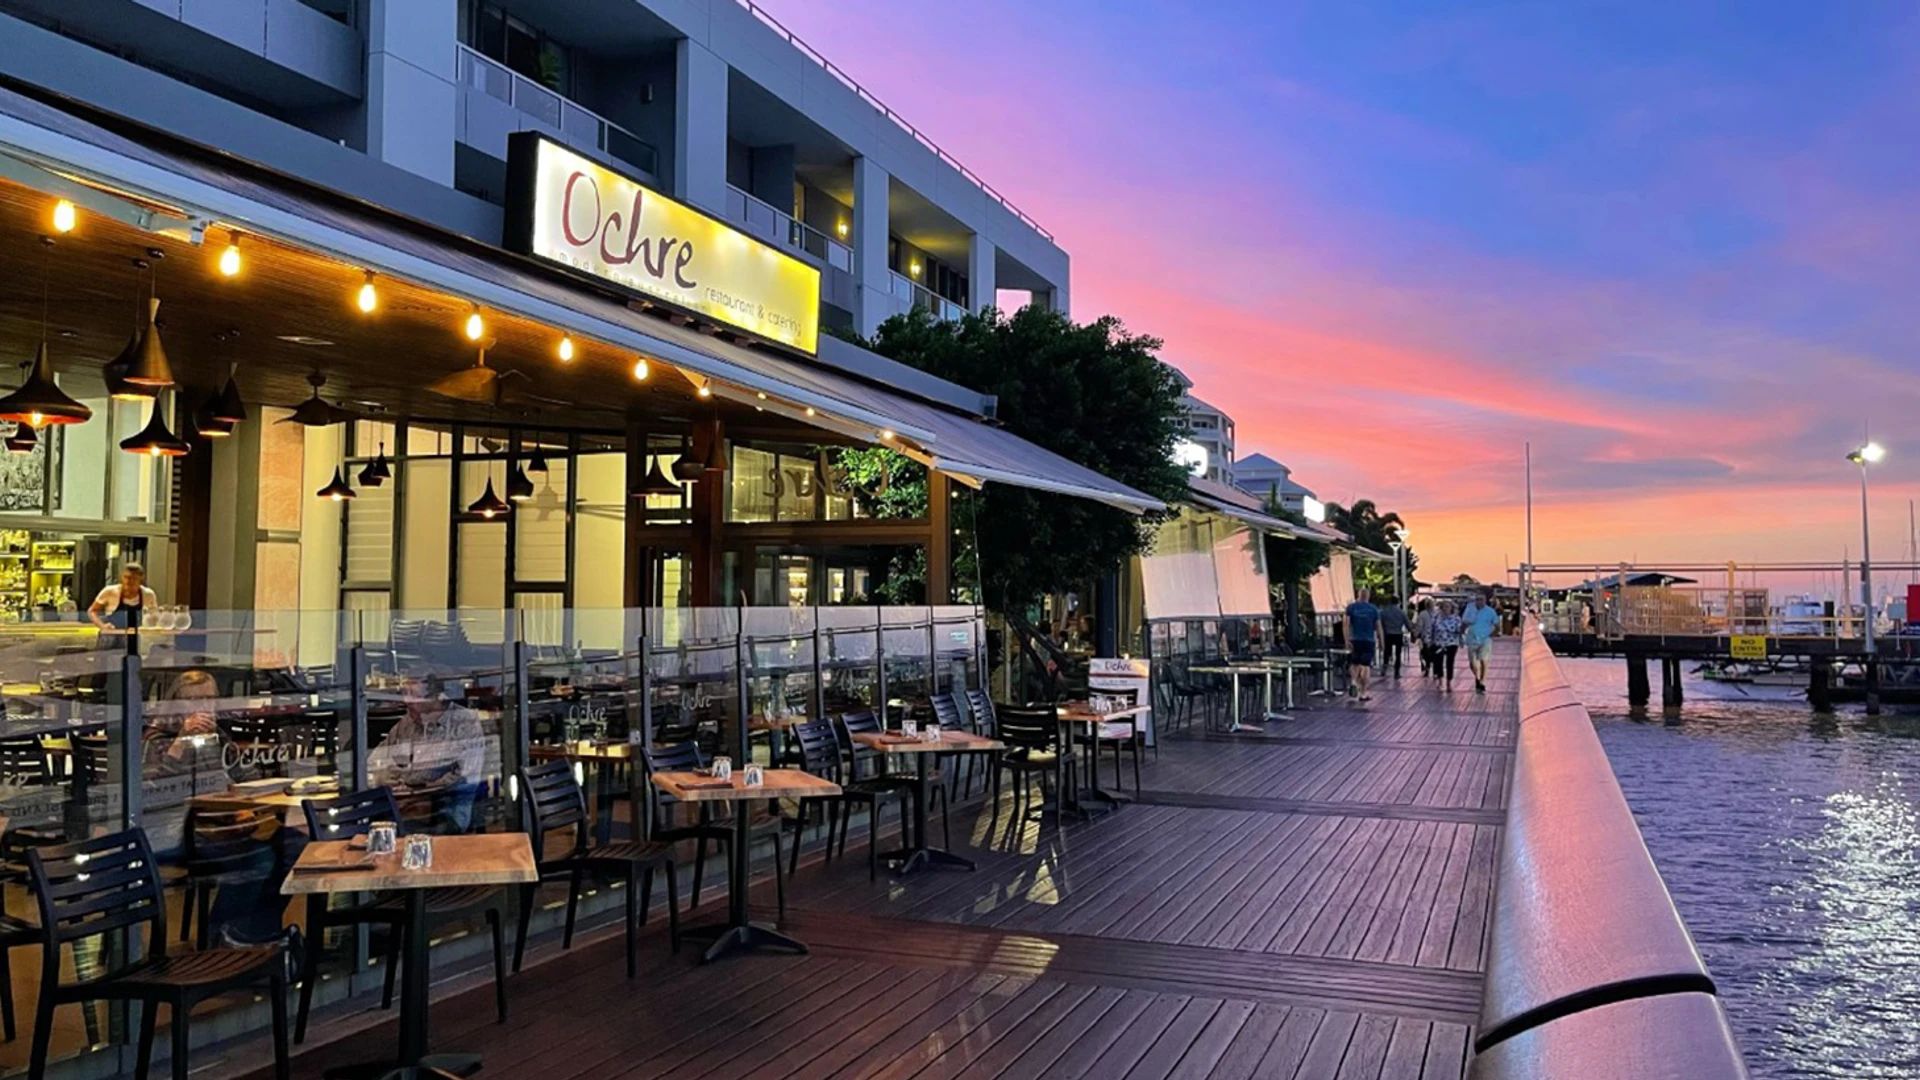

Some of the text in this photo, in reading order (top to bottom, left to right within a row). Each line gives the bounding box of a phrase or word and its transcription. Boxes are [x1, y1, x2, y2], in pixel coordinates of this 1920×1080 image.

[562, 171, 697, 289] Ochre
[704, 287, 755, 316] restaurant
[757, 303, 766, 320] &
[568, 699, 608, 725] Ochre
[221, 736, 291, 771] Ochre
